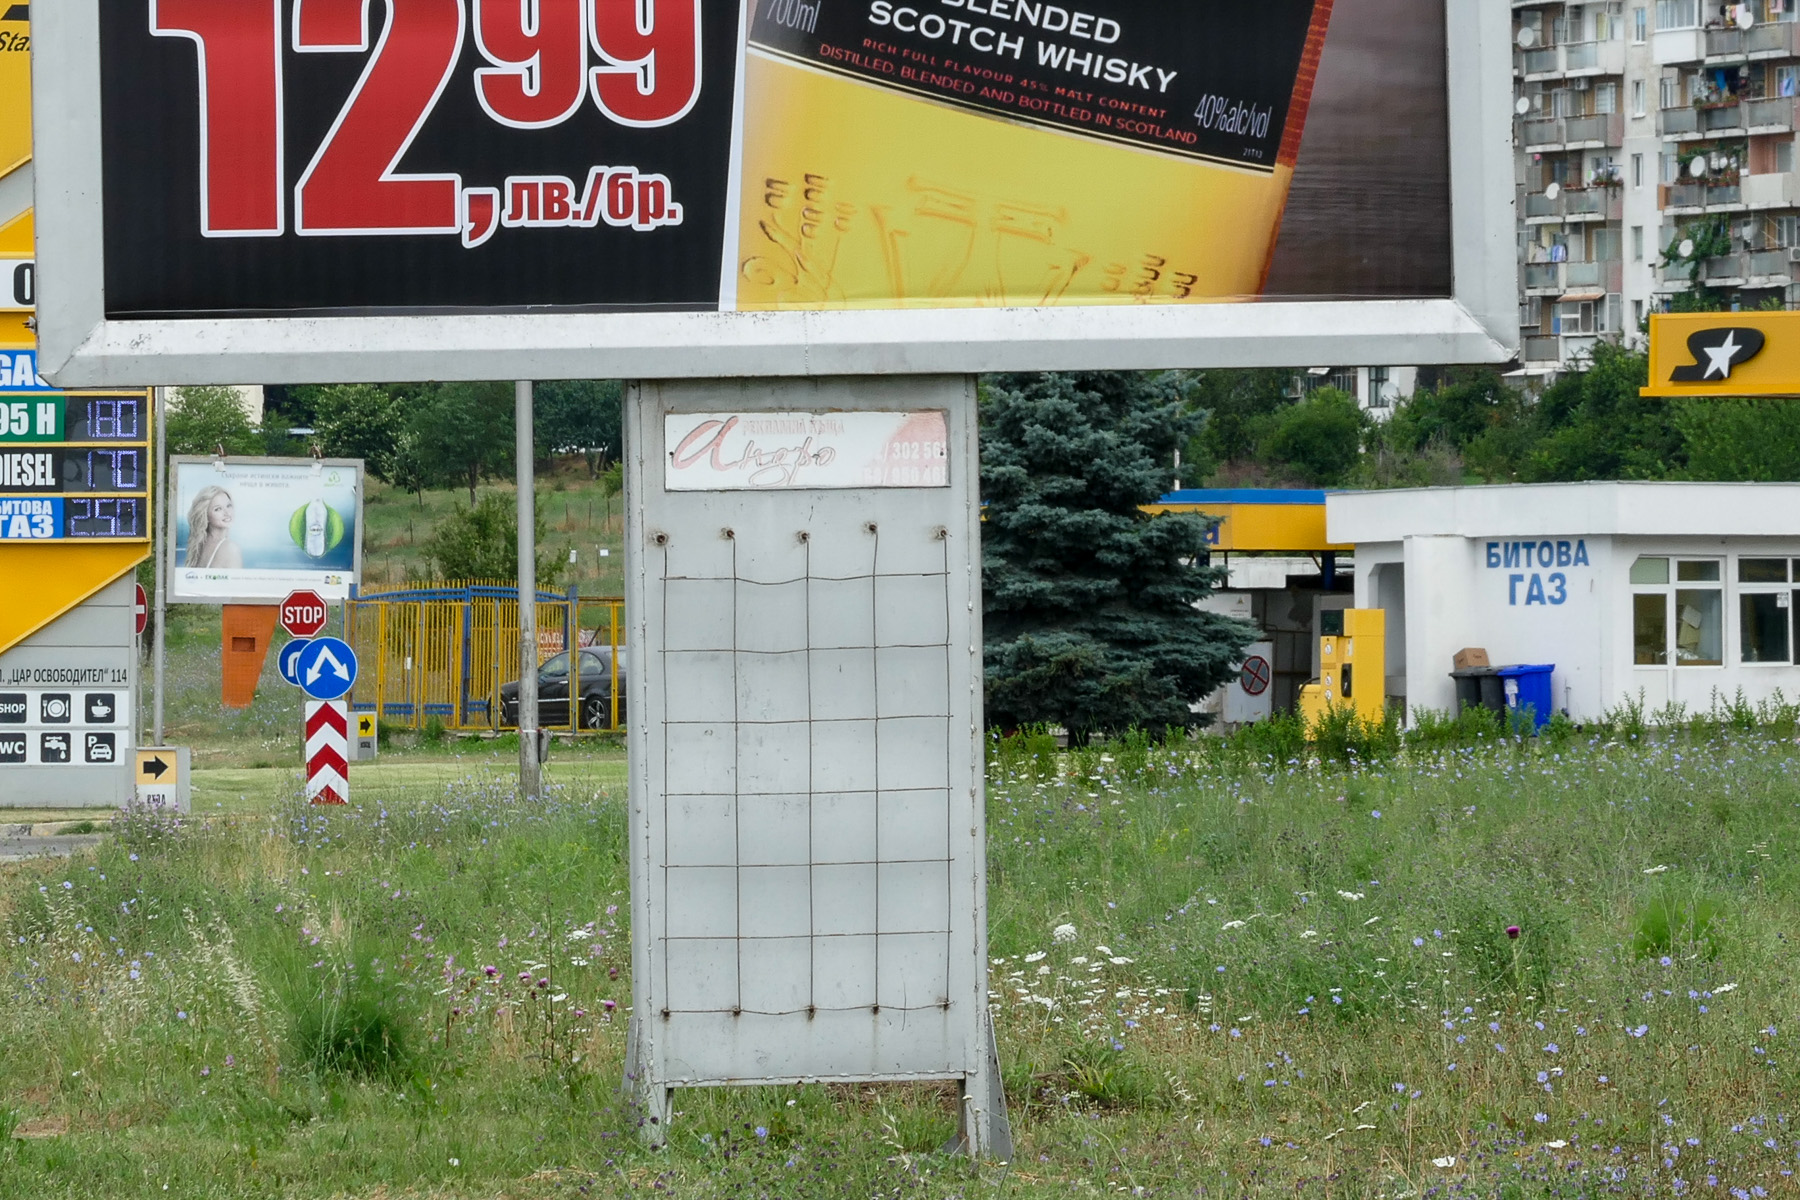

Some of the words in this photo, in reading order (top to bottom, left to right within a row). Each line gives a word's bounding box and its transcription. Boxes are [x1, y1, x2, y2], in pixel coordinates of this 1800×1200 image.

[0, 31, 30, 52] Sta
[868, 0, 1024, 61] SCOTCH
[1037, 40, 1177, 93] WHISKY
[863, 37, 897, 56] RICH
[902, 48, 937, 67] FULL
[944, 58, 1014, 84] FLAVOUR
[1054, 85, 1095, 103] MALT
[1099, 95, 1168, 120] CONTENT
[901, 65, 975, 95] BLENDED
[979, 85, 1015, 104] AND
[1018, 94, 1092, 122] BOTTLED
[1096, 114, 1112, 126] IN
[1116, 117, 1198, 145] SCOTLAND
[0, 353, 50, 387] GA
[0, 452, 56, 487] IESEL
[0, 499, 53, 515] ИТОВА
[1486, 538, 1590, 569] БИТОВА
[1508, 572, 1568, 606] ГАЗ
[284, 606, 323, 625] STOP
[111, 668, 127, 683] 114
